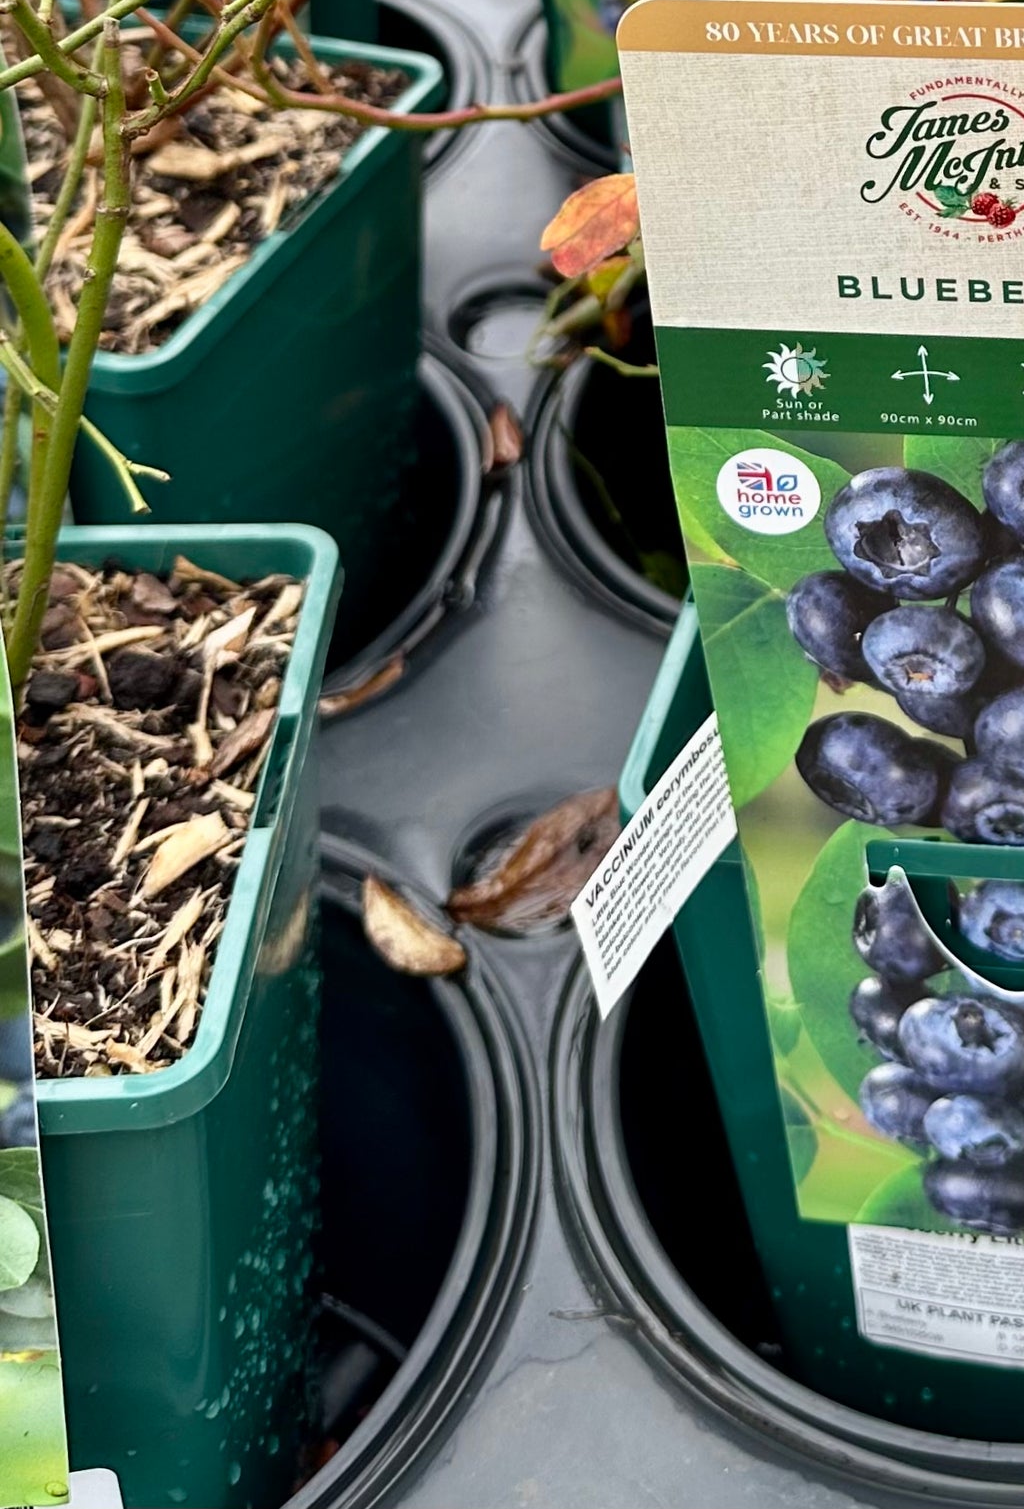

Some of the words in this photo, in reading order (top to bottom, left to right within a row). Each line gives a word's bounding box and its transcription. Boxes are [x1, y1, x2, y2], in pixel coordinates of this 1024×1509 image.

[705, 21, 740, 43] 80
[746, 22, 840, 44] YEARS
[846, 24, 885, 45] OF
[892, 24, 987, 48] GREAT
[866, 101, 1010, 159] James
[989, 177, 1001, 190] &
[928, 222, 960, 240] 1944
[776, 398, 802, 409] Sun
[808, 400, 823, 410] or
[762, 409, 791, 420] Part
[797, 410, 840, 422] shade
[880, 413, 920, 424] 90cm
[937, 415, 978, 426] 90cm
[737, 488, 802, 505] home
[738, 504, 804, 519] grown
[586, 807, 654, 908] VACCINIUM
[898, 1299, 923, 1313] UK
[927, 1304, 986, 1325] PLANT
